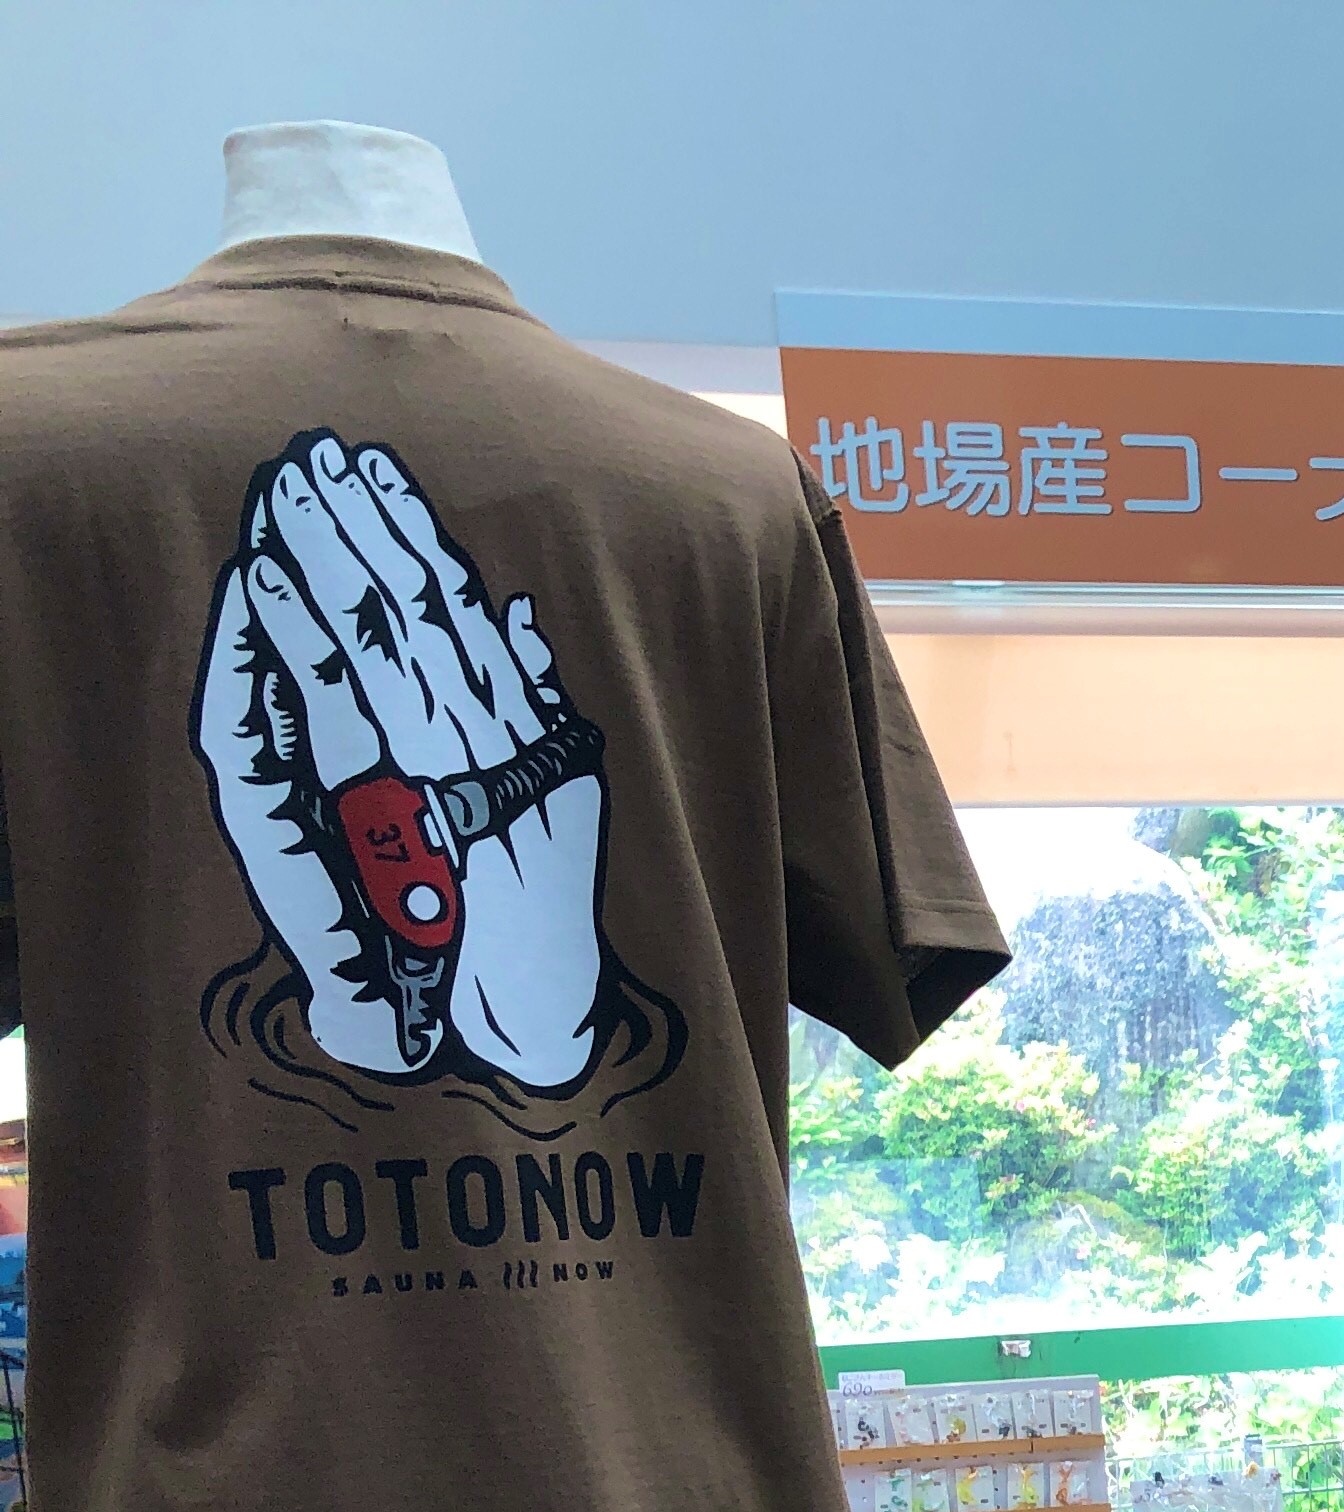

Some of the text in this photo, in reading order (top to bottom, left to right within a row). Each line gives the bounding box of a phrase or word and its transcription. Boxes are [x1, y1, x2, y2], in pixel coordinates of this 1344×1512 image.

[227, 1149, 706, 1261] TOTONOW
[332, 1260, 615, 1297] SAUNA NOW
